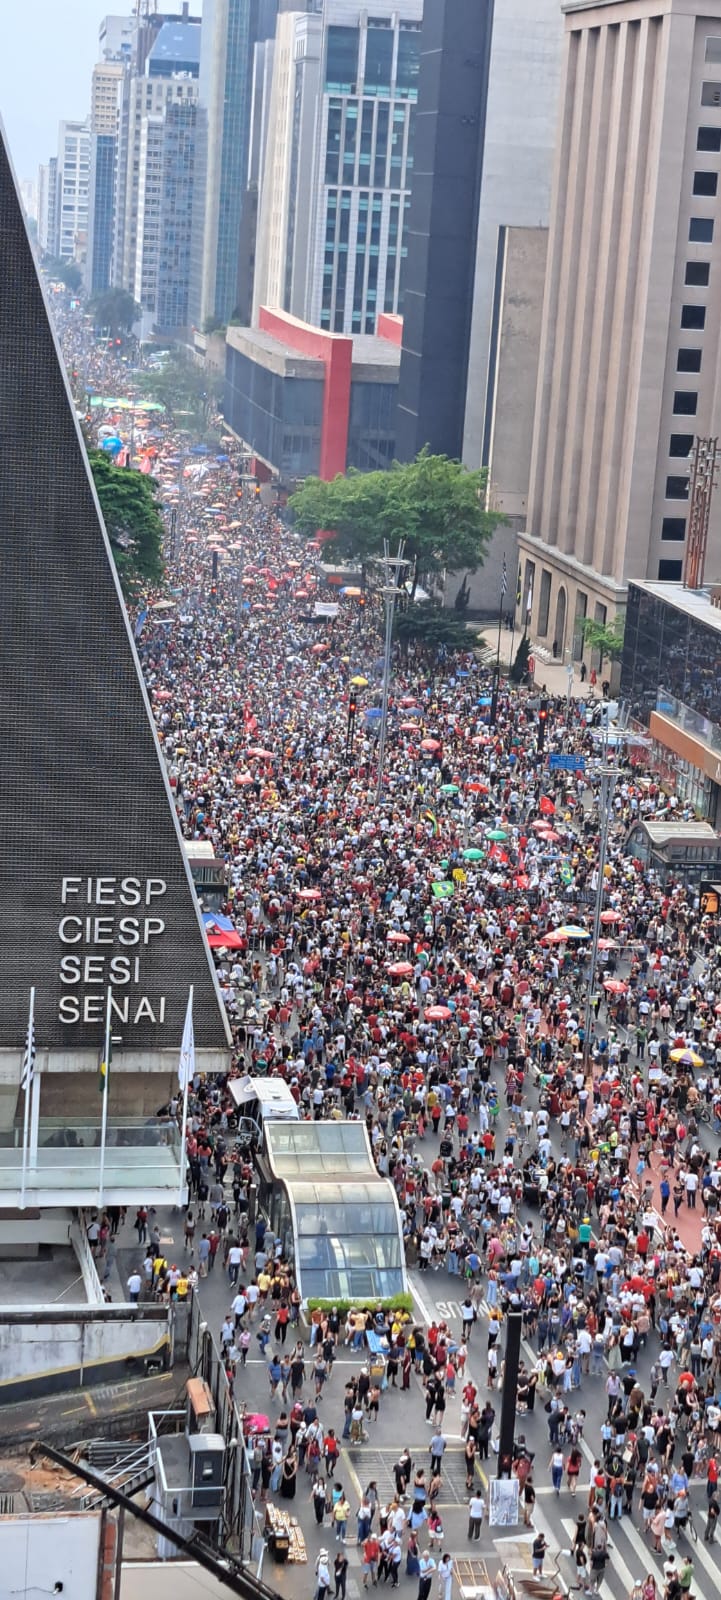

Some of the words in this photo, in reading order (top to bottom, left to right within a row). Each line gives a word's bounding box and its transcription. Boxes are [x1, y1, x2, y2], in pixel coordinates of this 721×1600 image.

[61, 877, 167, 905] FIESP
[58, 915, 165, 945] CIESP
[59, 955, 139, 984] SESI
[58, 995, 165, 1023] SENAI
